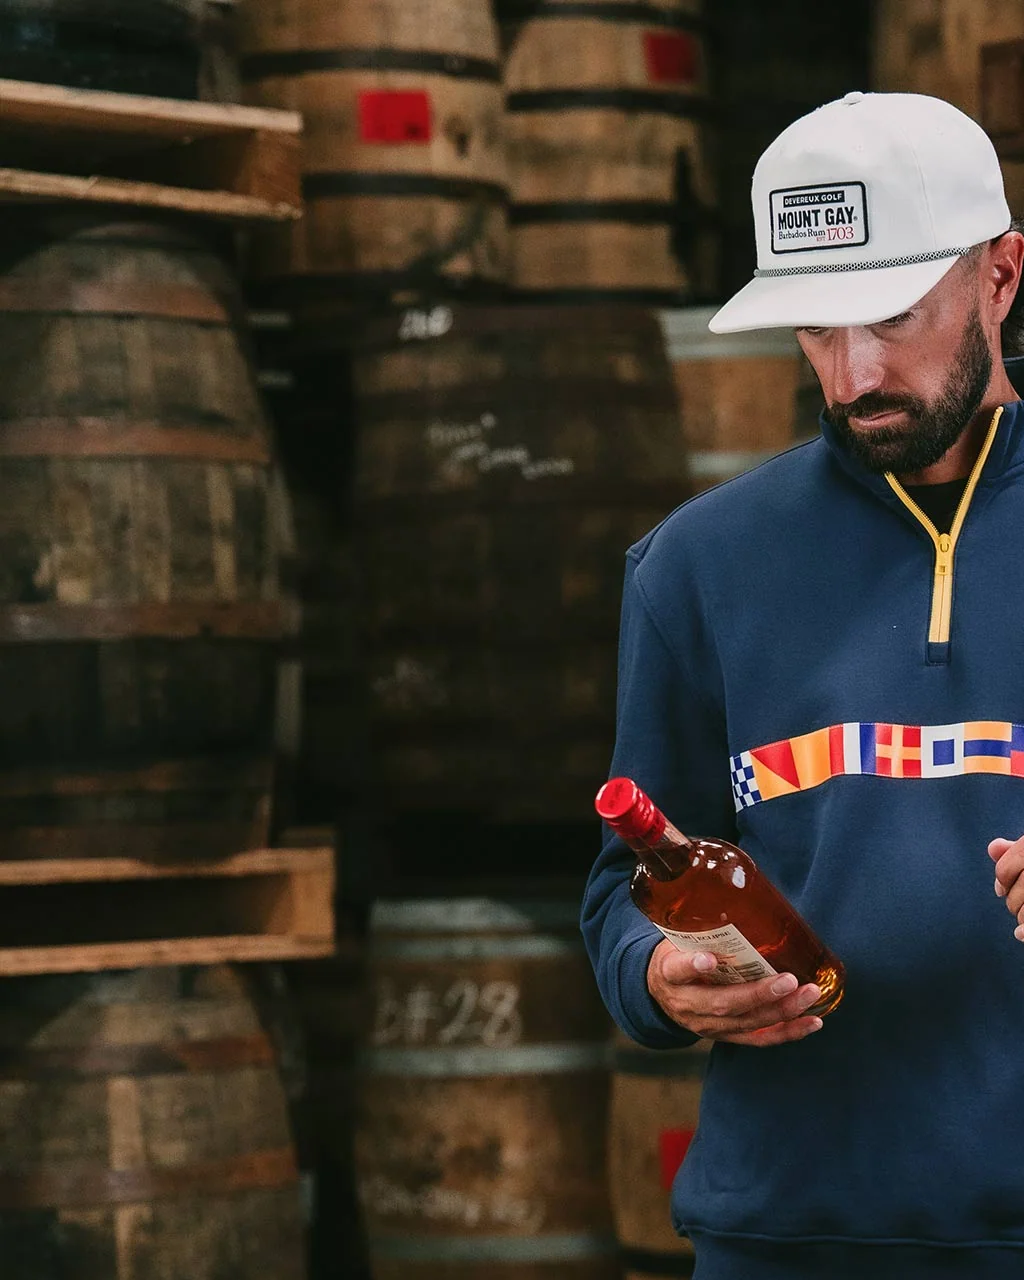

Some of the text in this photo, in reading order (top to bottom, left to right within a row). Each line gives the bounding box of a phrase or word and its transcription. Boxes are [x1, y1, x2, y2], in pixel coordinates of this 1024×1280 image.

[784, 193, 843, 206] DEVEREUX GOLF
[778, 206, 855, 231] MOUNT GAY
[778, 226, 855, 241] Barbados Rum 1703
